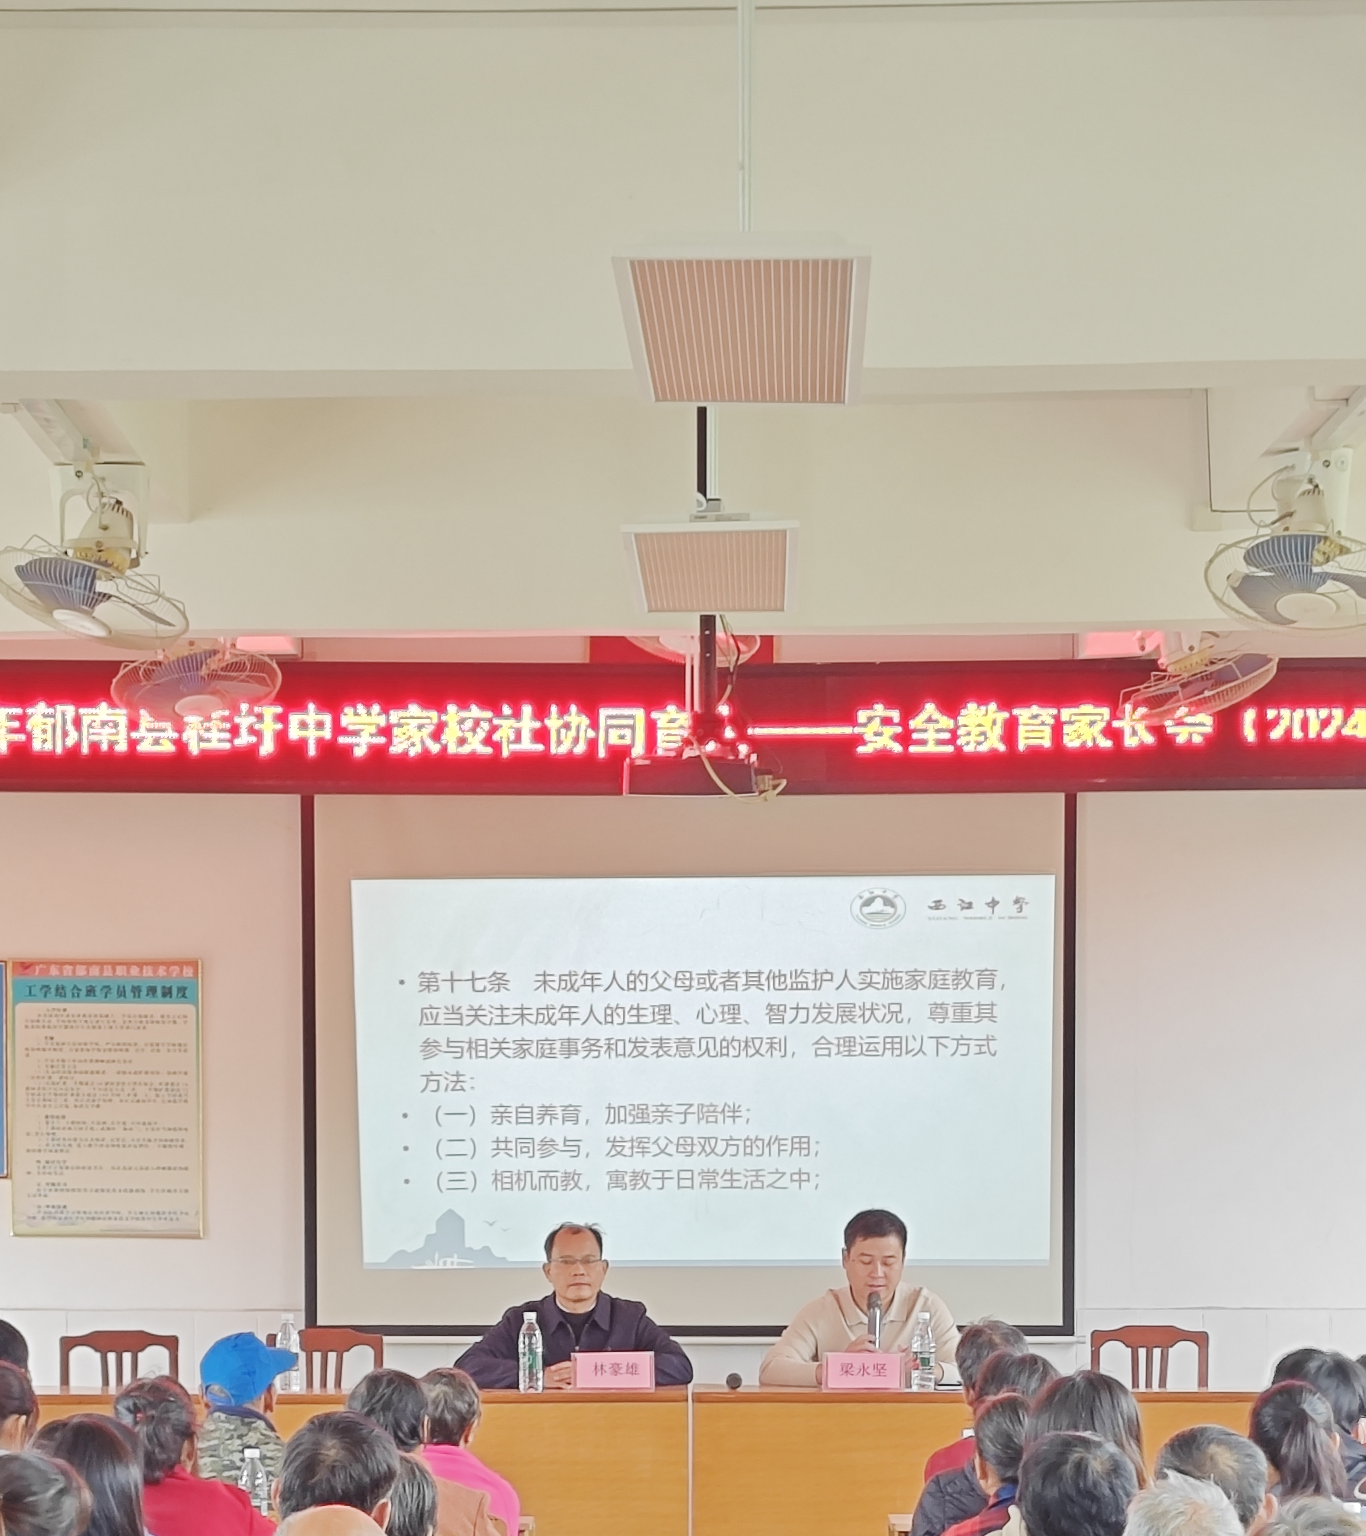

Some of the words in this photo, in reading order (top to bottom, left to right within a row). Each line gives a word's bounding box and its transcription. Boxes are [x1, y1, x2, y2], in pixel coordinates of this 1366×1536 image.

[34, 963, 194, 978] 广东省郁南县职业技术学校
[417, 969, 511, 994] 第十七条
[533, 967, 1007, 994] 未成年人的父母或者其他监护人实施家庭教育，
[24, 983, 189, 999] 工学结合班学员管理制度
[418, 1001, 999, 1027] 应当关注未成年人的生理、心理、智力发展状况，尊重其
[419, 1034, 998, 1060] 参与相关家庭事务和发表意见的权利，合理运用以下方式
[419, 1069, 476, 1094] 方法：
[592, 1361, 641, 1377] 林豪雄
[838, 1362, 888, 1378] 梁永坚
